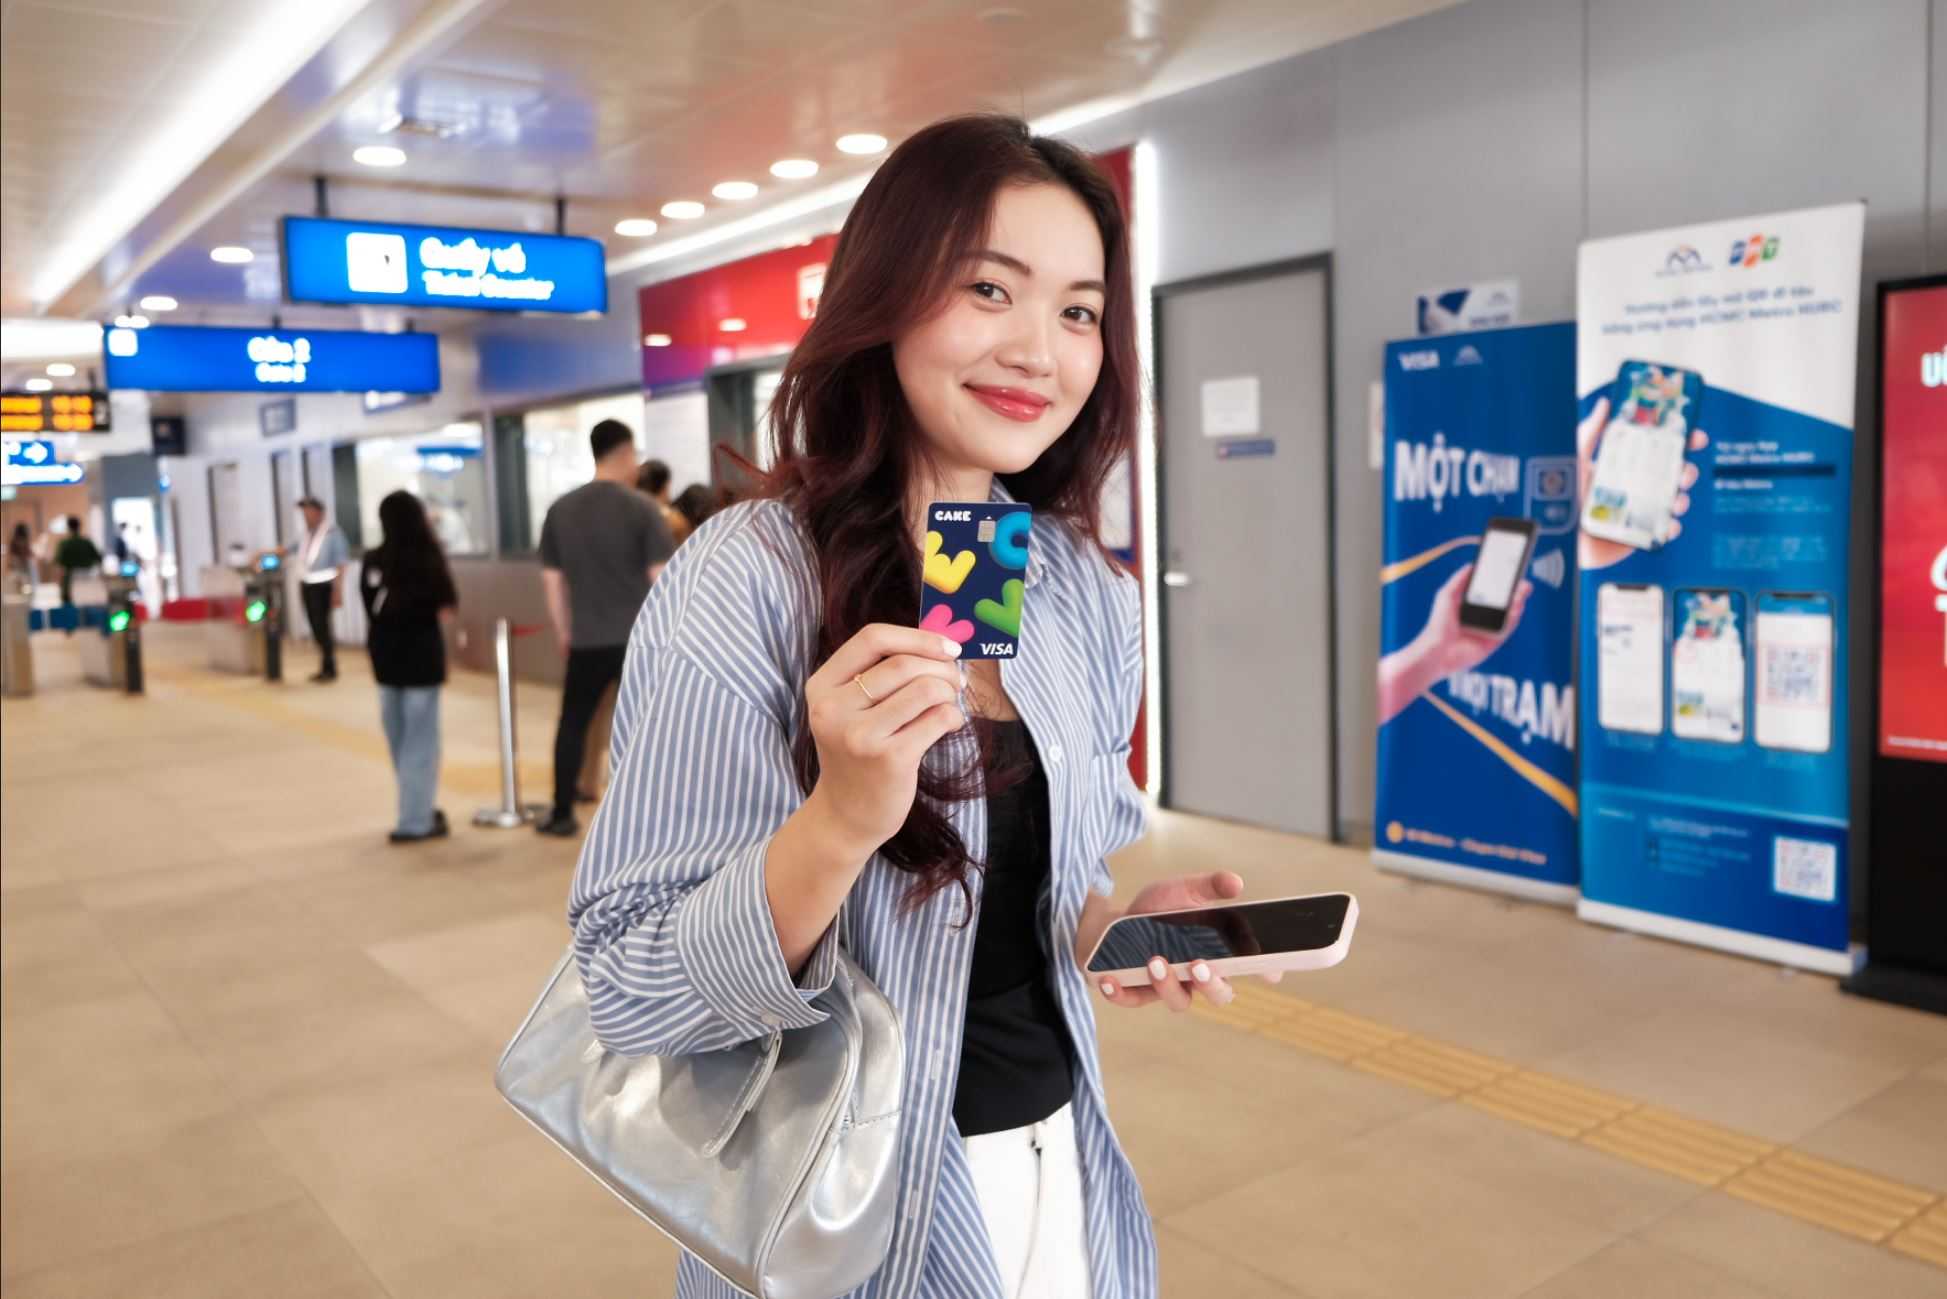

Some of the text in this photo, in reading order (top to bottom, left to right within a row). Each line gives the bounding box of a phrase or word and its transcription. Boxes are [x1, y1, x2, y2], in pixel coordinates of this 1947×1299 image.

[1394, 432, 1465, 514] MỘT
[935, 510, 972, 522] CAKE
[980, 643, 1014, 655] VISA
